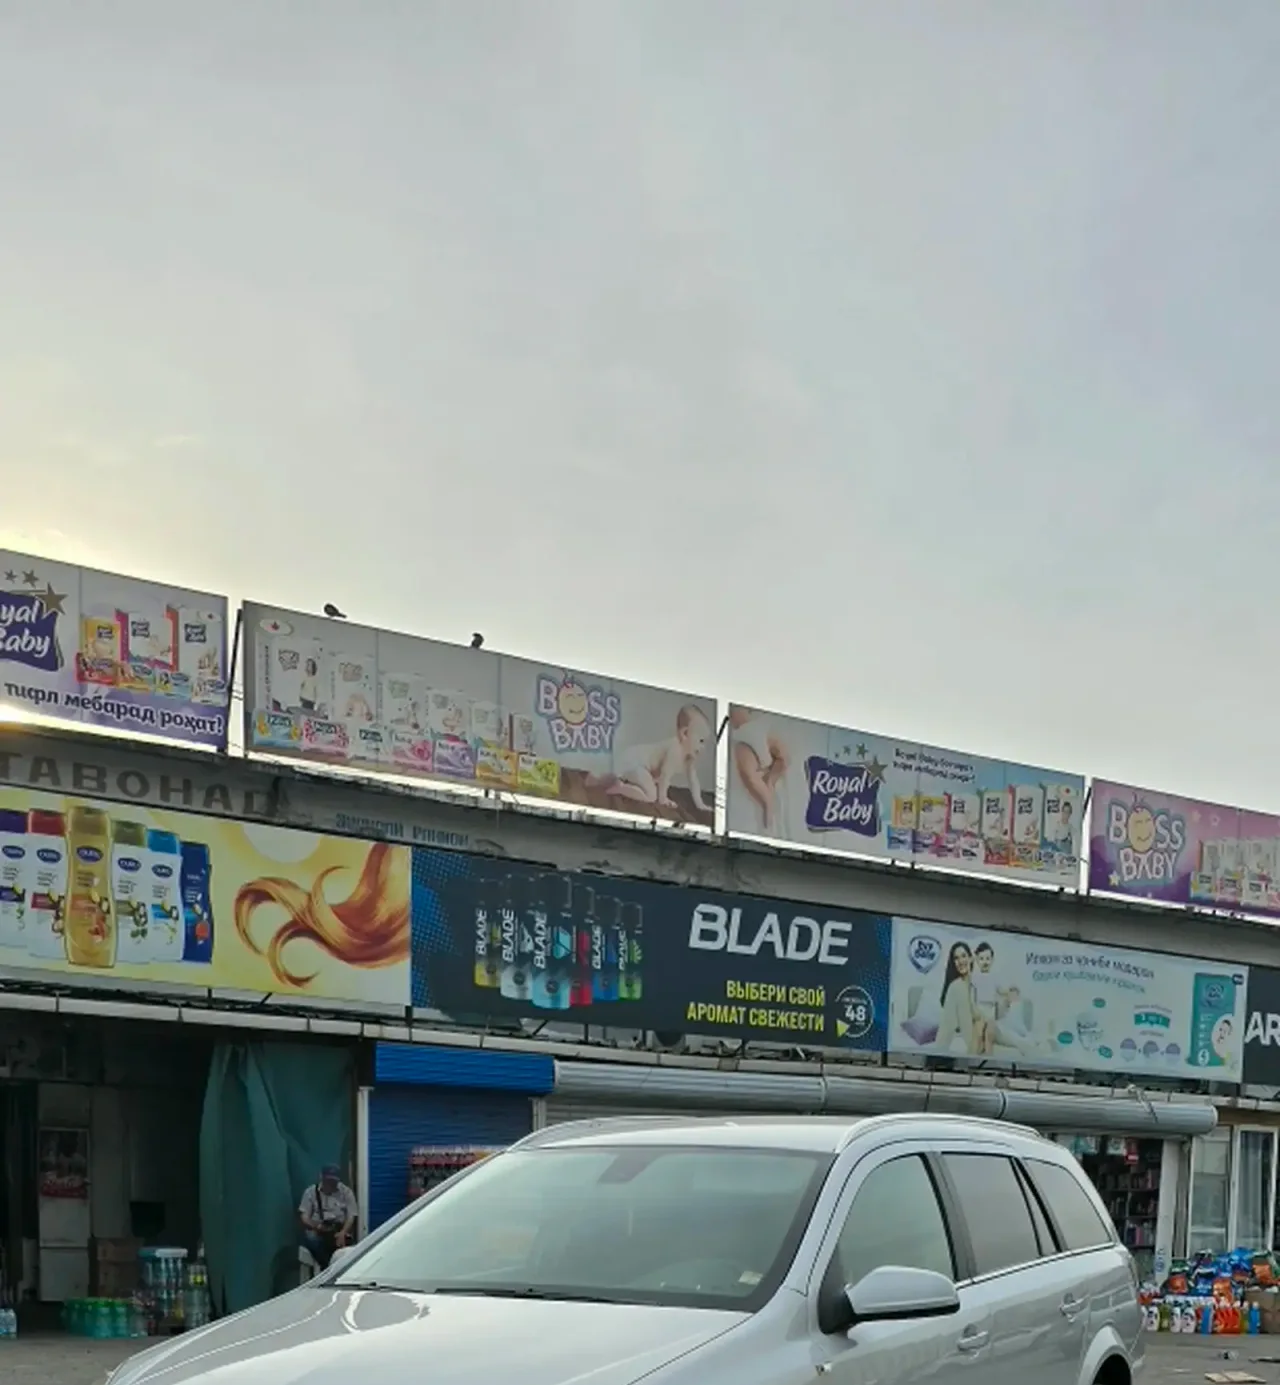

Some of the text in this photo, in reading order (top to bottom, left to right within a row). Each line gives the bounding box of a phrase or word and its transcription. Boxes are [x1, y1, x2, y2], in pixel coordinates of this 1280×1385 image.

[5, 681, 59, 705] тифл
[64, 690, 156, 725] мебарад
[538, 678, 620, 725] BOSS
[551, 717, 615, 750] BABY
[813, 770, 867, 800] Royal
[823, 798, 874, 825] Baby
[1108, 803, 1184, 850] BOSS
[1119, 848, 1178, 882] BABY
[475, 908, 487, 955] BLADE
[502, 908, 515, 962] BLADE
[533, 910, 548, 969] BLADE
[688, 903, 853, 965] BLADE
[726, 979, 825, 1006] ВЫБЕРИ СВОЙ
[687, 1001, 825, 1032] АРОМАТ СВЕЖЕСТИ
[845, 1004, 866, 1022] 48
